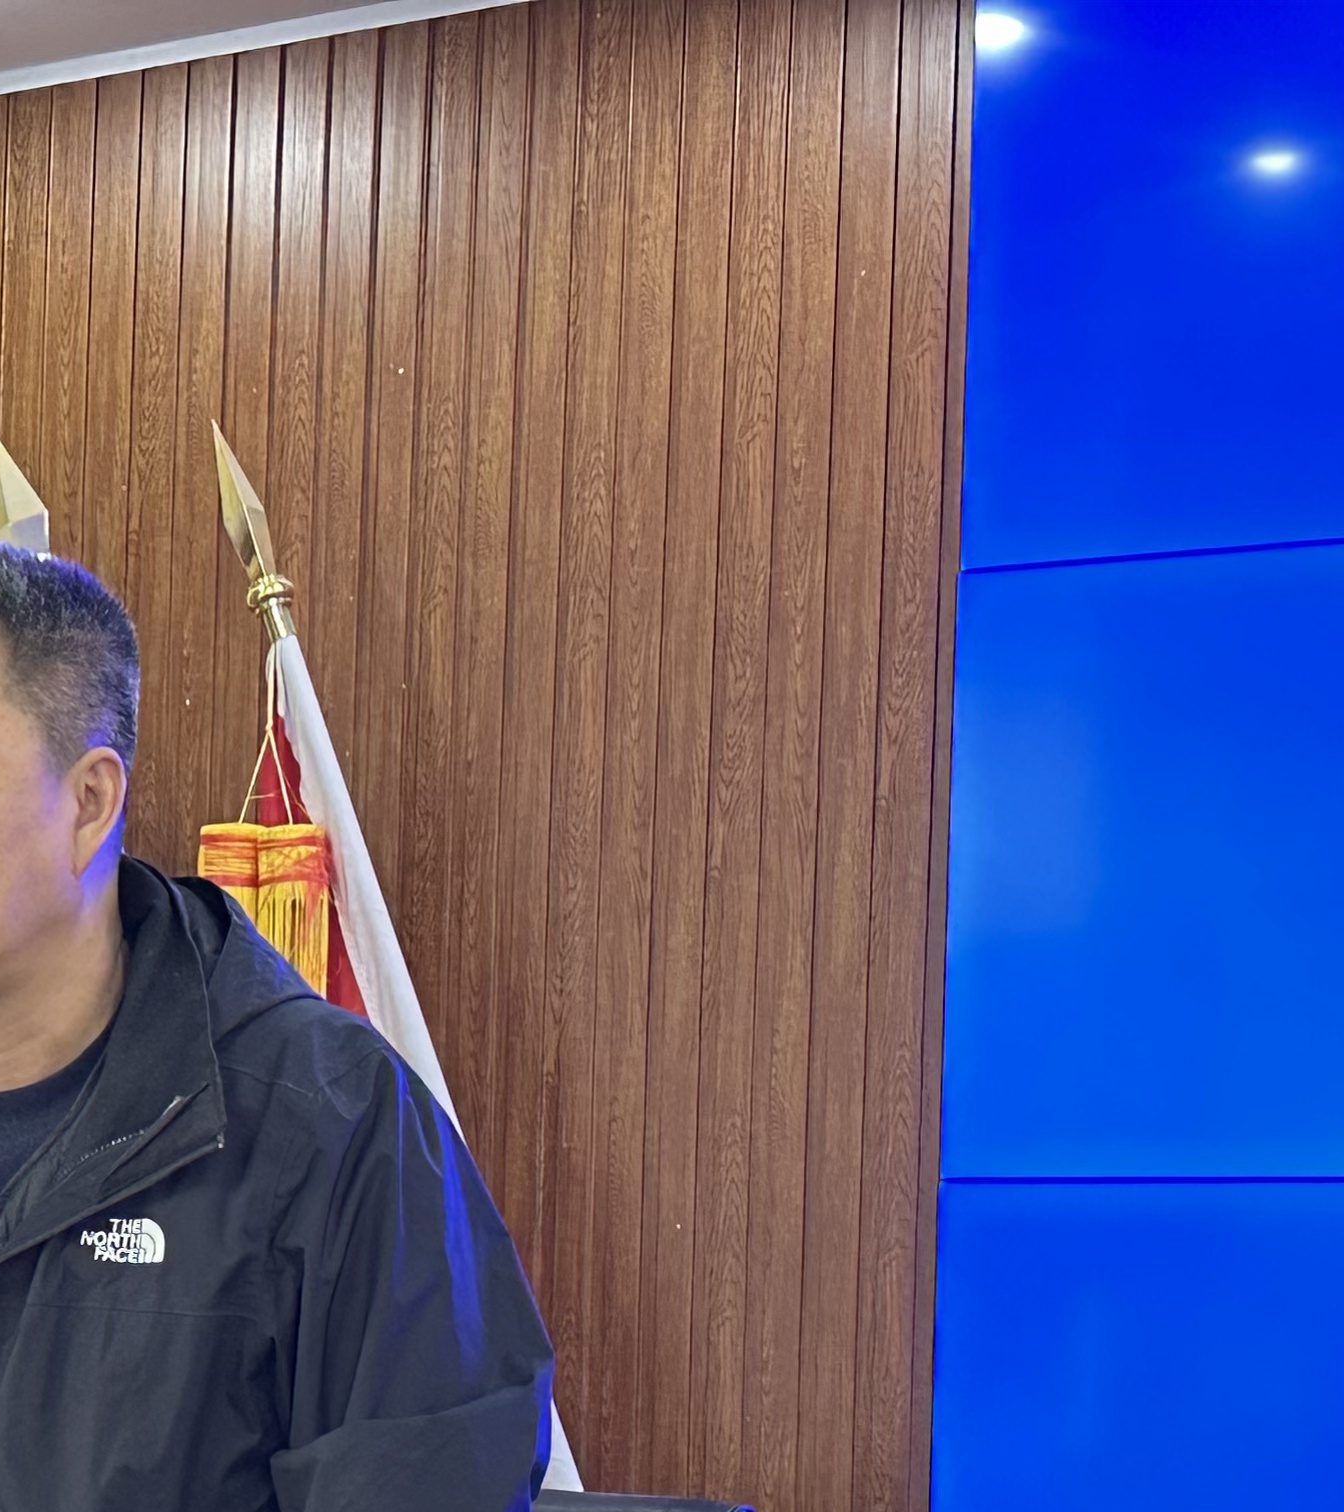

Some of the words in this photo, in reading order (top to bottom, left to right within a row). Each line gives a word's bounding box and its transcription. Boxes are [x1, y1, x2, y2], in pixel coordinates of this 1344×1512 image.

[110, 1218, 142, 1234] THE
[80, 1231, 142, 1249] NORTH
[94, 1246, 140, 1264] FACE
